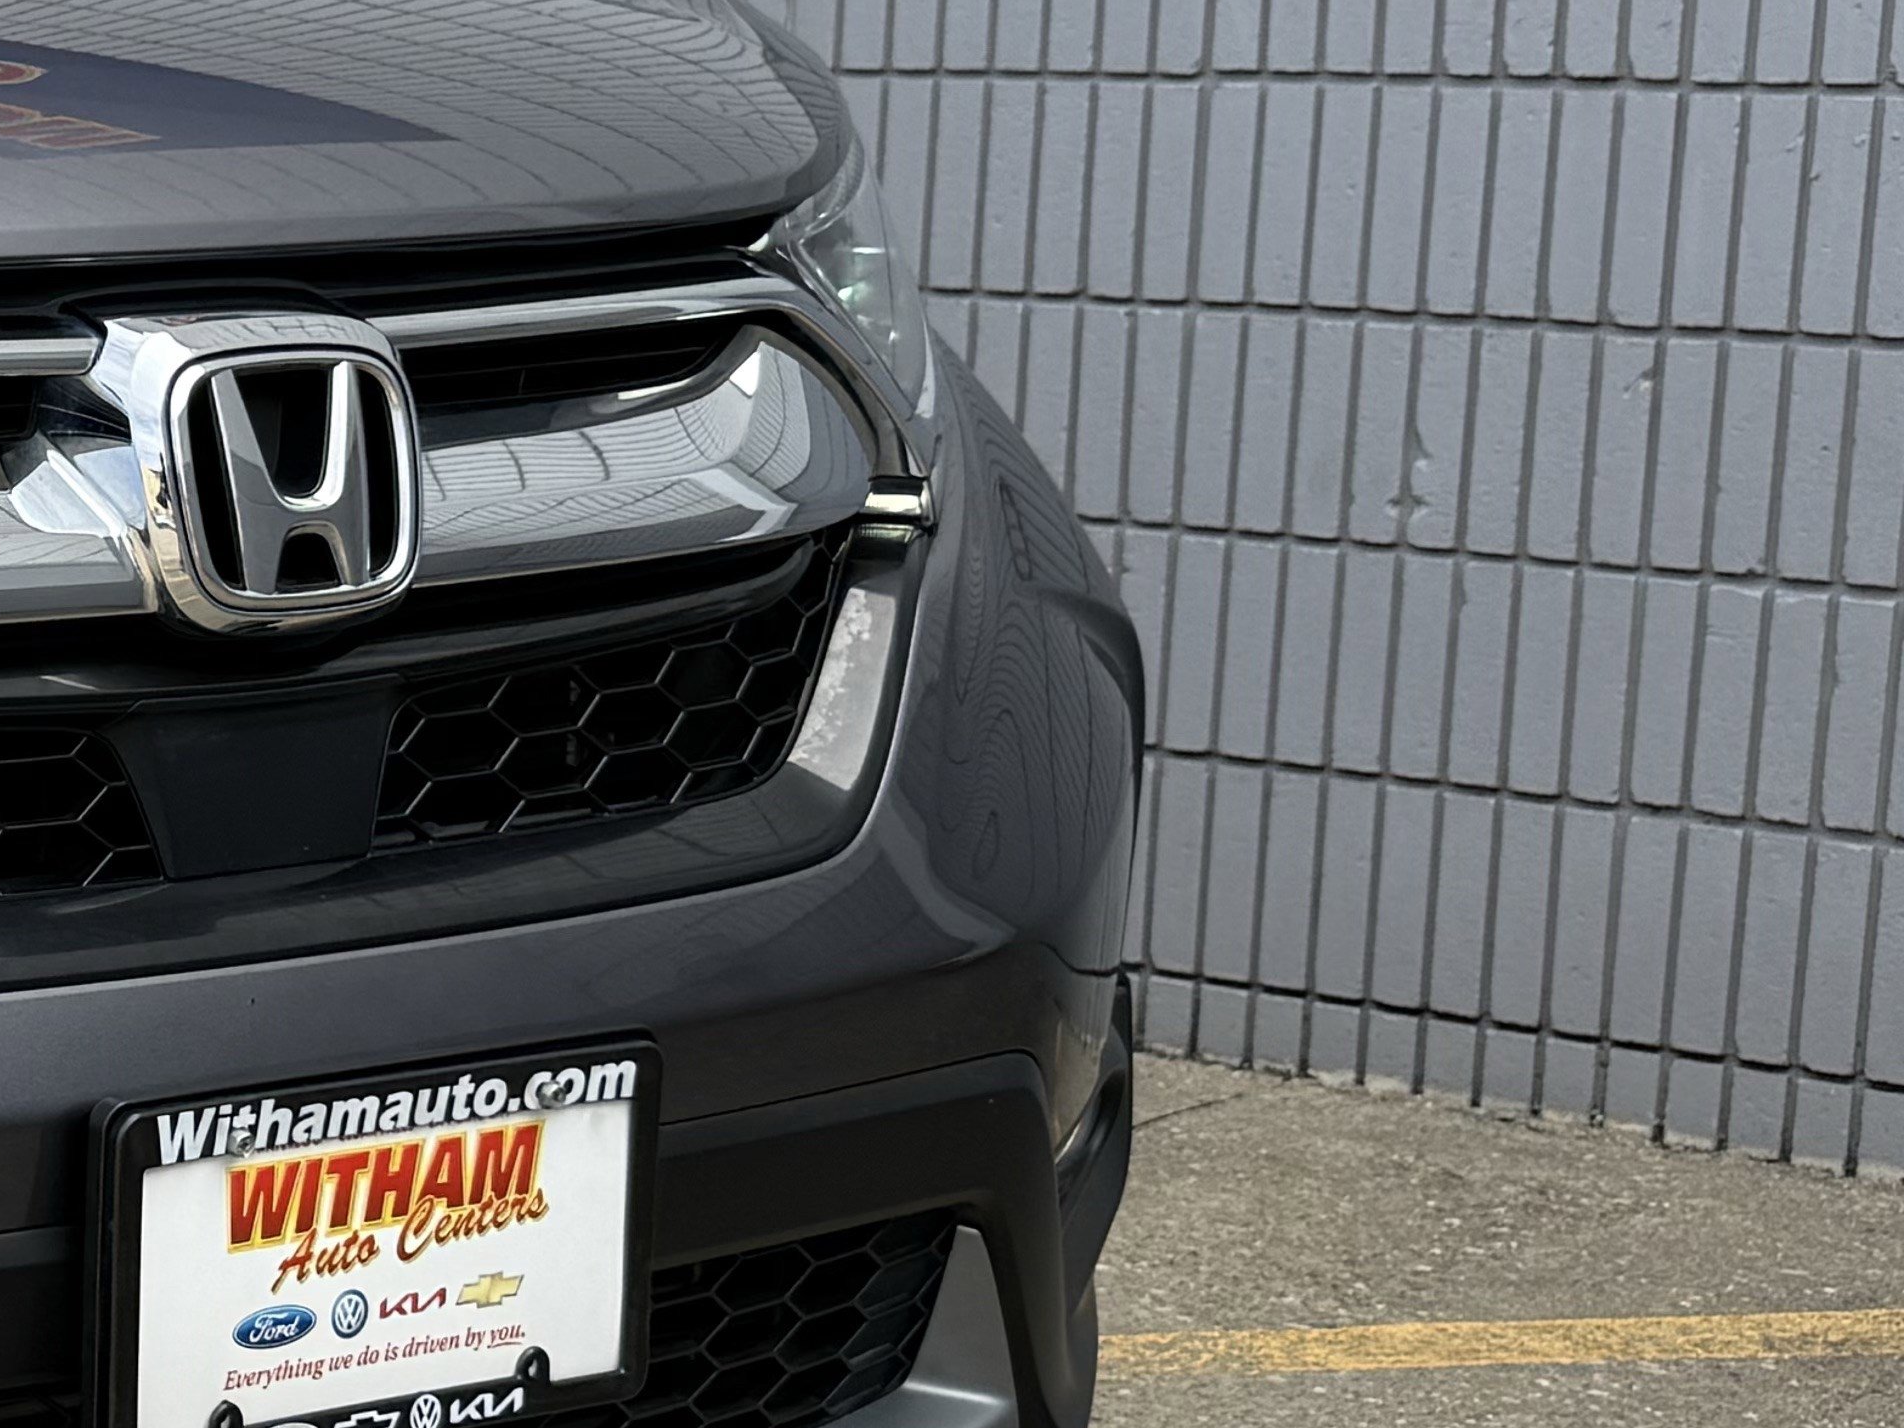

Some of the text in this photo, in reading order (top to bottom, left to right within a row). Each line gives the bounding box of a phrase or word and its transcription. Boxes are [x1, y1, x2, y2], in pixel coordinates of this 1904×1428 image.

[157, 1059, 637, 1166] Withamauto.com
[225, 1119, 546, 1253] WITHAM
[271, 1186, 549, 1295] Auto Centers
[223, 1324, 526, 1391] Everything we do is driven by you.
